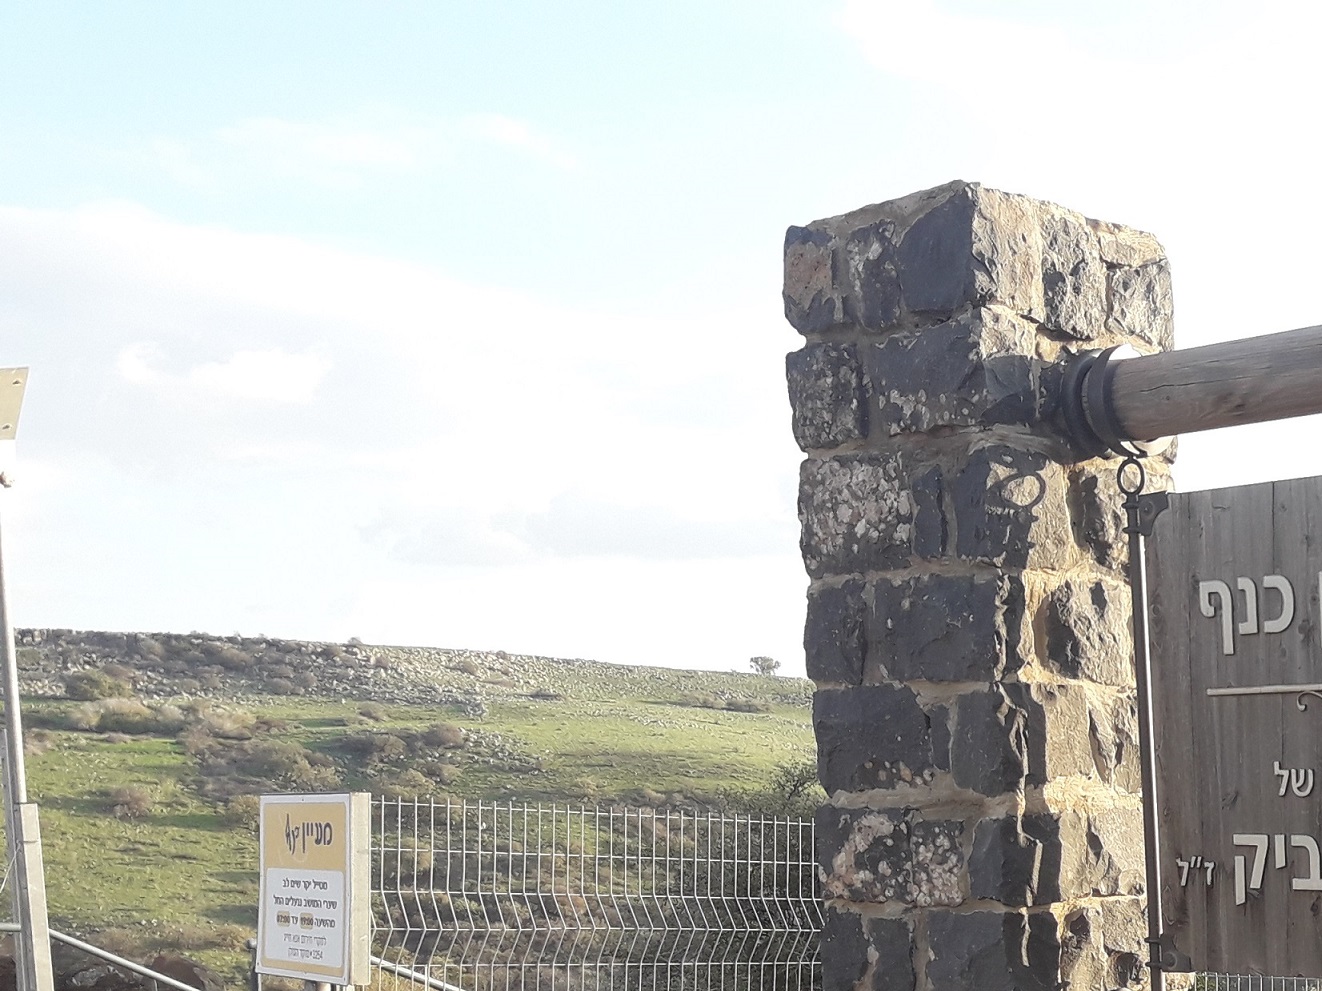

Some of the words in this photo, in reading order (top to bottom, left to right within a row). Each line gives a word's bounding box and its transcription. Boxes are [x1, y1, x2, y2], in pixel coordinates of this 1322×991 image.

[1198, 574, 1295, 656] כנף
[1272, 760, 1315, 797] של
[302, 821, 333, 854] מעיין
[282, 877, 290, 888] לב
[290, 879, 302, 889] שים
[302, 880, 312, 891] יקר
[291, 915, 299, 925] עד
